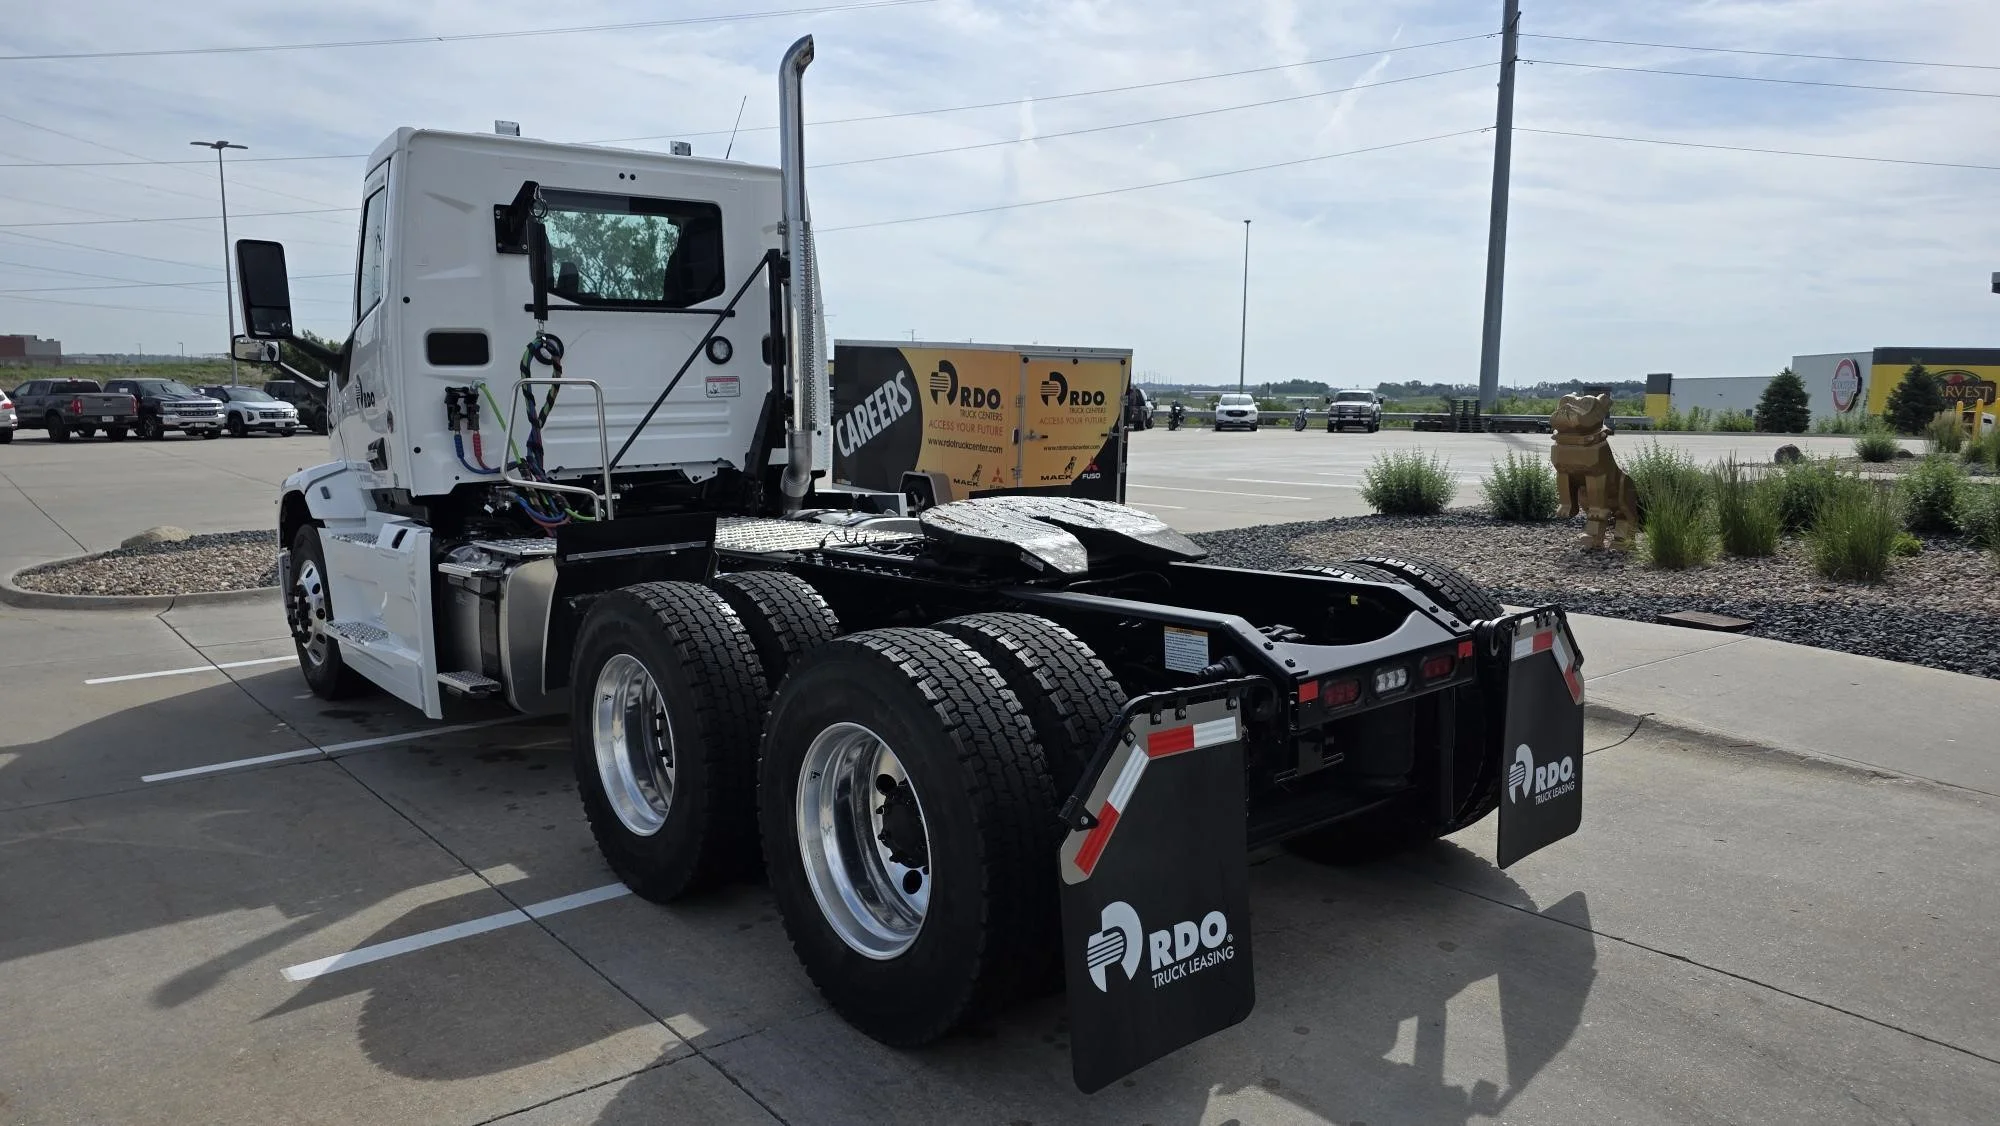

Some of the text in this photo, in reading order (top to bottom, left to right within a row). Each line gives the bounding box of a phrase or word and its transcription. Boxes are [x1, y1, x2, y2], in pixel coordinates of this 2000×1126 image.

[960, 386, 1001, 410] RDO
[1069, 390, 1105, 406] RDO
[1936, 385, 1993, 402] ARVEST
[836, 370, 912, 457] CAREERS
[960, 409, 1003, 422] TRUCK CENTERS
[1040, 417, 1063, 425] ACCESS
[929, 420, 1004, 437] ACCESS YOUR FUTURE
[928, 437, 1003, 454] www.rdotruckcenter.com
[953, 478, 978, 487] MACK
[1082, 472, 1101, 480] FUSO
[1535, 756, 1573, 794] RDO
[1535, 781, 1575, 805] TRUCK LEASING
[1149, 910, 1227, 972] RDO
[1152, 945, 1235, 989] TRUCK LEASING
